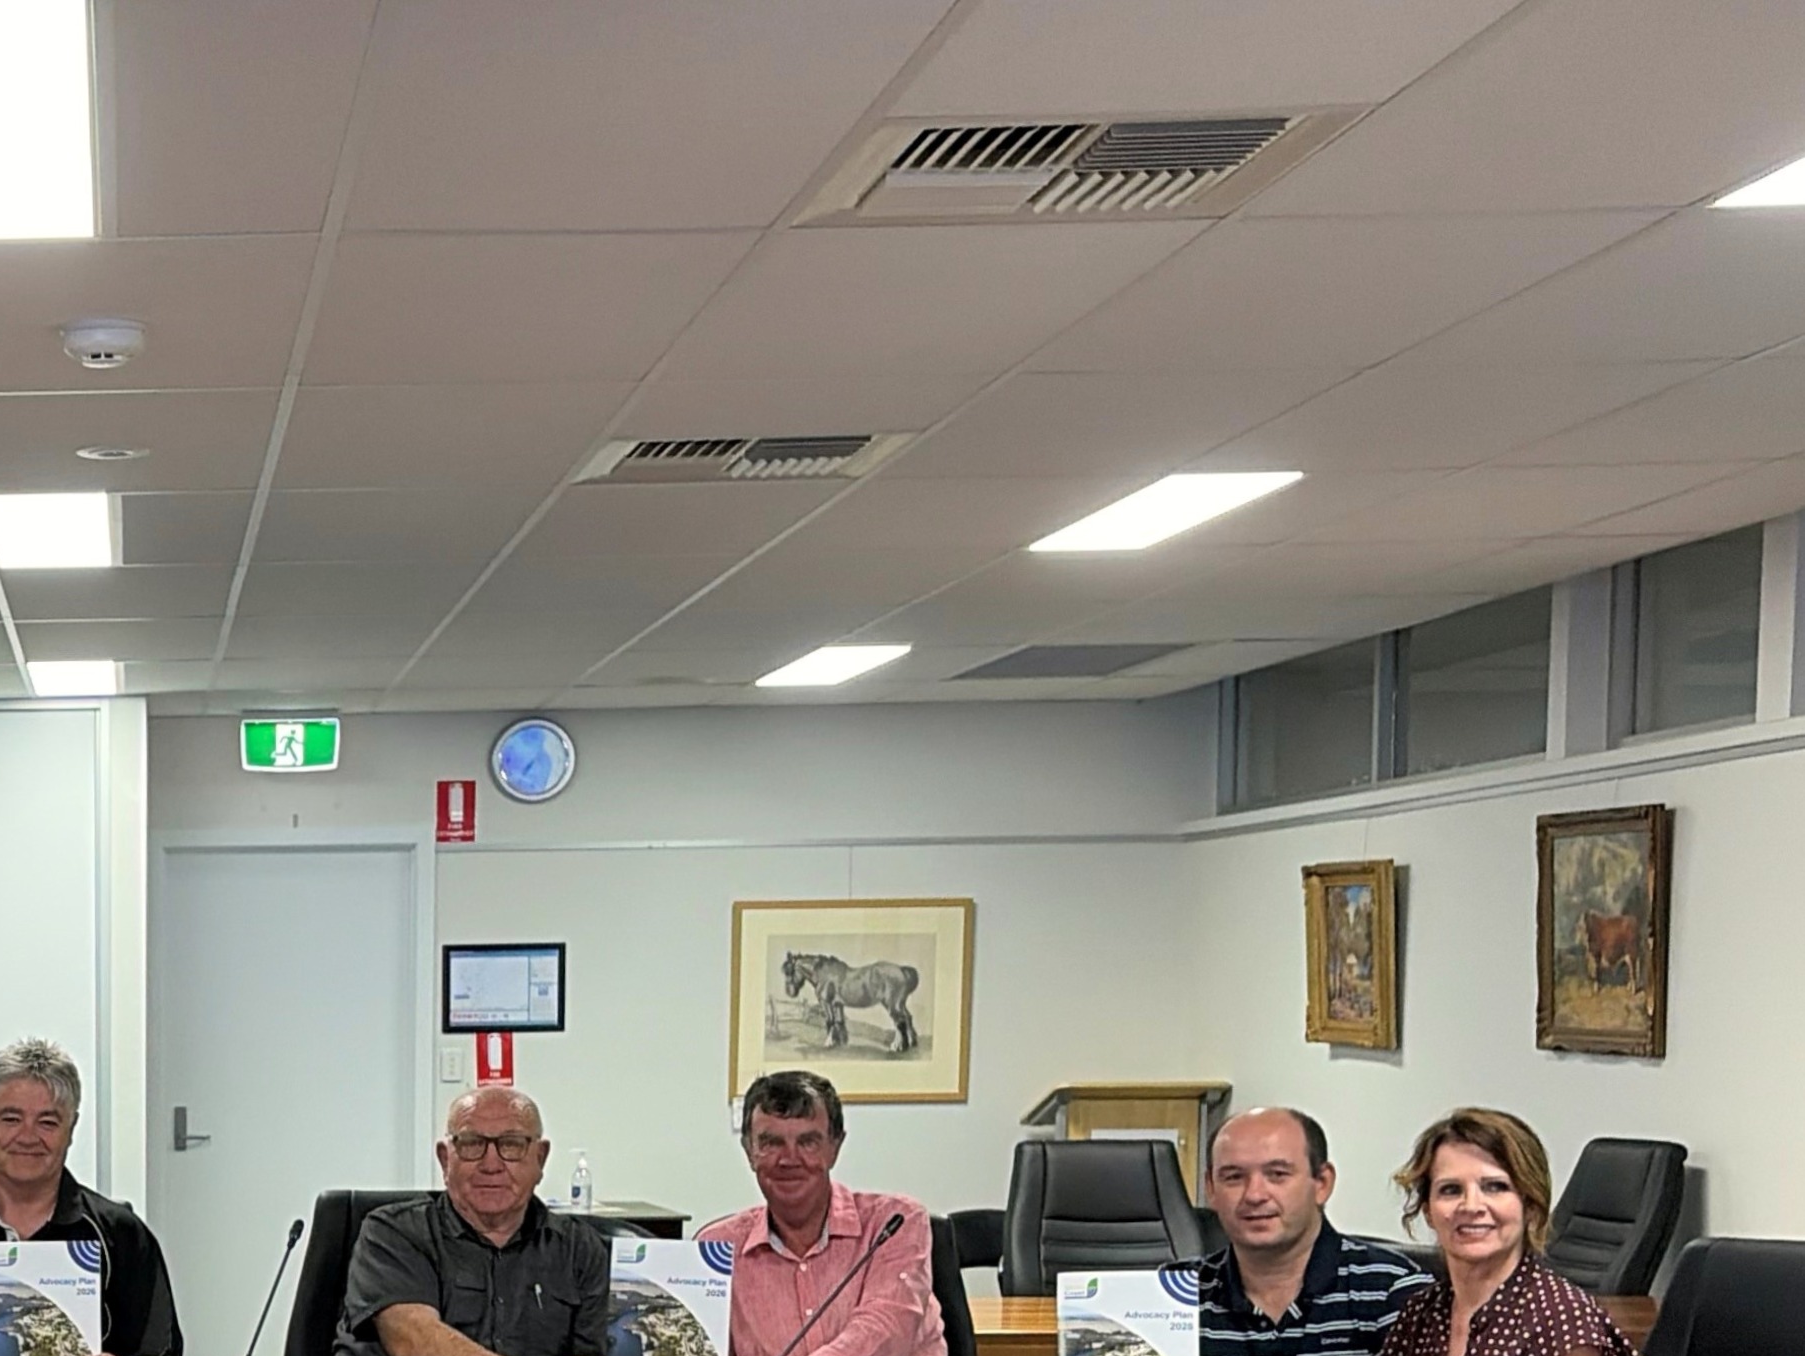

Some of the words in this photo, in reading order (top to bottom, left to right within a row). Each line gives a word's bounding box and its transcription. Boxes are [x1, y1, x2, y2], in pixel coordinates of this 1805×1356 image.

[39, 1277, 76, 1286] Advocacy
[78, 1277, 96, 1285] Plan
[667, 1277, 707, 1287] Advocacy
[76, 1288, 96, 1296] 2026
[706, 1289, 726, 1297] 2026
[1124, 1310, 1170, 1320] Advocacy
[1172, 1310, 1193, 1319] Plan
[1169, 1322, 1193, 1331] 2026
